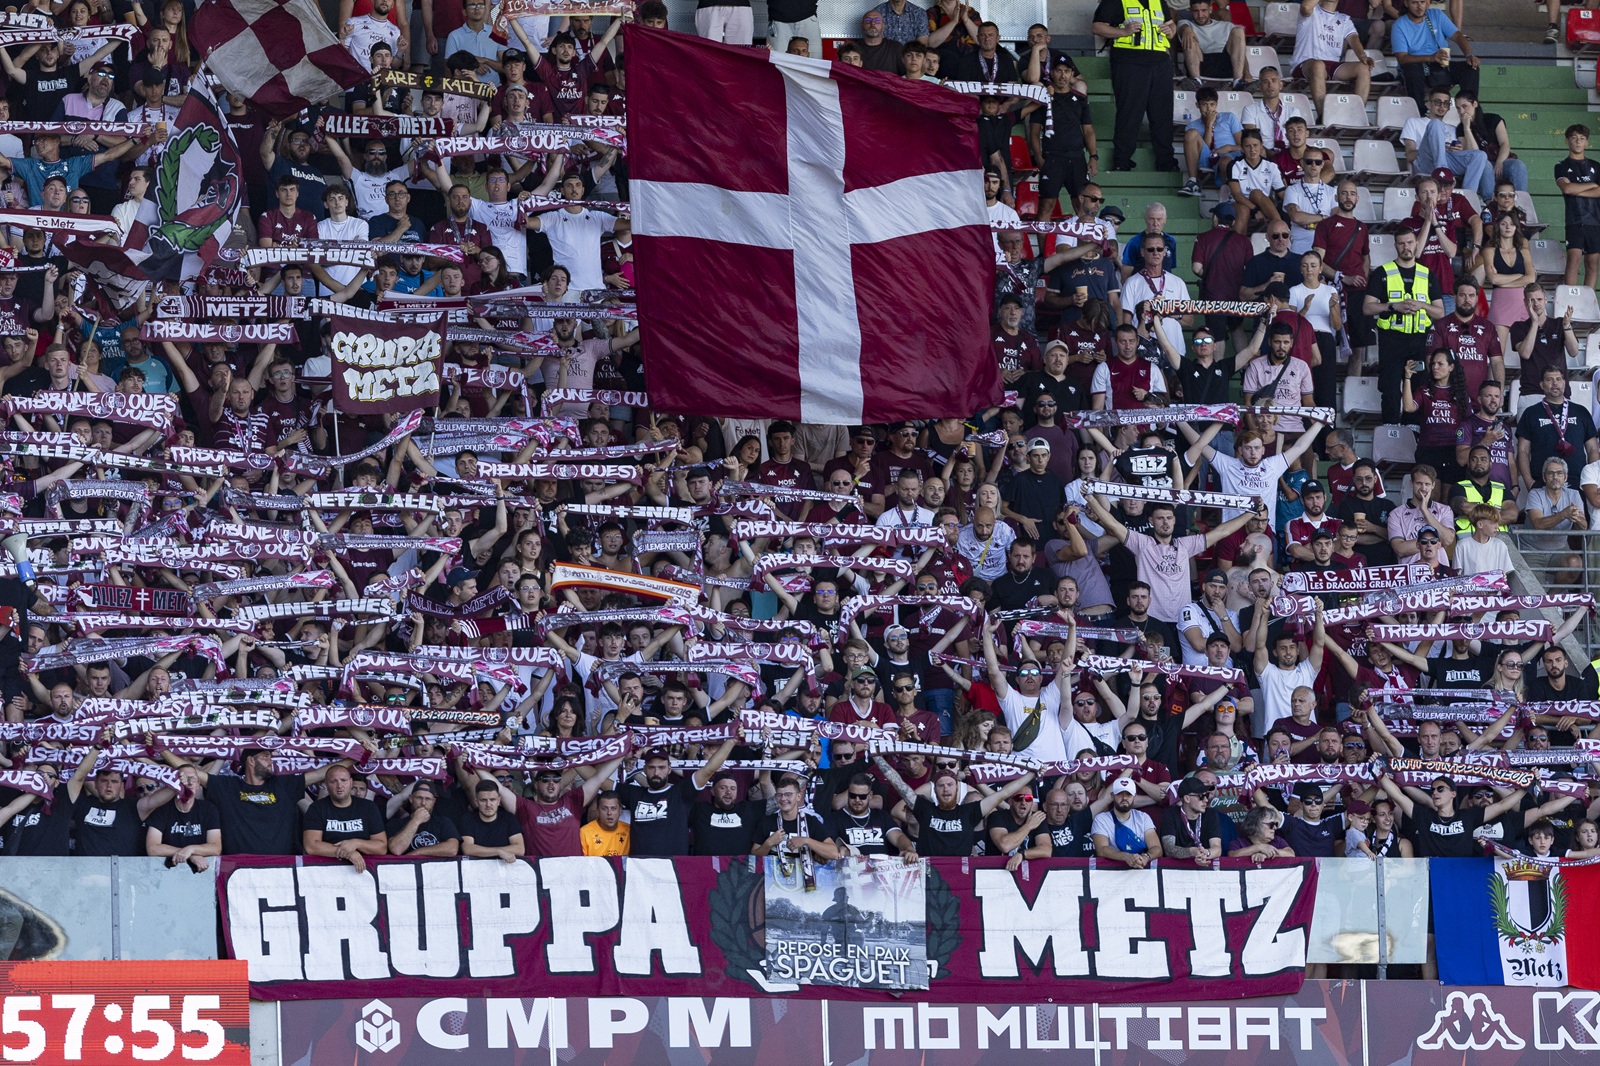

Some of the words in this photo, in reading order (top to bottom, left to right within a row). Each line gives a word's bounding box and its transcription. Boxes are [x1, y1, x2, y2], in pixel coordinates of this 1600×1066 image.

[8, 12, 50, 29] MET
[1580, 11, 1592, 19] 42
[1251, 48, 1260, 56] 46
[385, 70, 417, 85] ARE
[0, 121, 61, 131] RIBUNE
[325, 115, 369, 134] ALLEZ
[399, 118, 437, 135] METZ
[571, 116, 627, 126] TRIBU
[435, 137, 503, 150] TRIBUNE
[1398, 189, 1408, 197] 45
[36, 217, 48, 226] Fc
[51, 218, 75, 229] Metz
[1059, 221, 1103, 240] OUES
[1372, 236, 1381, 244] 46
[1536, 240, 1546, 248] 43
[325, 250, 376, 267] OUES
[207, 304, 268, 317] METZ
[575, 311, 598, 319] POUR
[146, 321, 218, 340] TRIBUNE
[244, 324, 292, 340] OUEST
[447, 333, 482, 342] EULEMENT
[1459, 346, 1477, 354] CAR
[343, 362, 440, 401] METZ
[129, 394, 177, 412] OUES
[1120, 415, 1163, 424] SEULEMENT
[1432, 409, 1450, 417] CAR
[434, 424, 475, 432] SEULEMENT
[170, 446, 245, 464] TRIBUNE
[478, 462, 550, 477] RIBUNE
[1130, 455, 1167, 473] 1932
[70, 489, 112, 498] SEULEMENT
[114, 490, 135, 499] POUR
[1094, 481, 1172, 501] GRUPPA
[1194, 493, 1252, 509] METZ
[901, 527, 945, 541] OUES
[265, 543, 309, 560] OUES
[1306, 571, 1344, 582] F.C.
[1350, 567, 1406, 581] METZ
[1310, 582, 1324, 590] LES
[1327, 581, 1366, 590] DRAGONS
[1370, 580, 1406, 588] GRENATS
[91, 586, 132, 608] ALLEZ
[462, 587, 507, 615] METZ
[336, 599, 391, 614] OUES
[76, 616, 165, 631] TRIBUNE
[1374, 623, 1459, 639] TRIBUNE
[1488, 620, 1549, 637] OUEST
[76, 653, 122, 664] SEULEMENT
[511, 647, 558, 664] OUES
[1413, 712, 1455, 720] SEULEMENT
[1555, 701, 1600, 717] OUES
[46, 725, 101, 741] OUEST
[740, 709, 817, 730] TRIBUNE
[845, 726, 896, 742] OUES
[157, 735, 257, 746] TRIBUNE
[382, 757, 443, 775] OUEST
[1510, 756, 1558, 765] SEULEMENT
[1560, 755, 1581, 763] POUR
[846, 827, 884, 846] 1932
[227, 864, 703, 982] GRUPPA
[974, 867, 1307, 978] METZ
[778, 941, 841, 957] REPOSE
[848, 944, 868, 959] EN
[875, 947, 910, 961] PAIX
[777, 955, 910, 984] SPAGUET
[1506, 957, 1563, 982] Metz
[1, 994, 226, 1061] 57:55
[416, 997, 752, 1050] CMPM
[976, 1005, 1327, 1051] MULTIBAT
